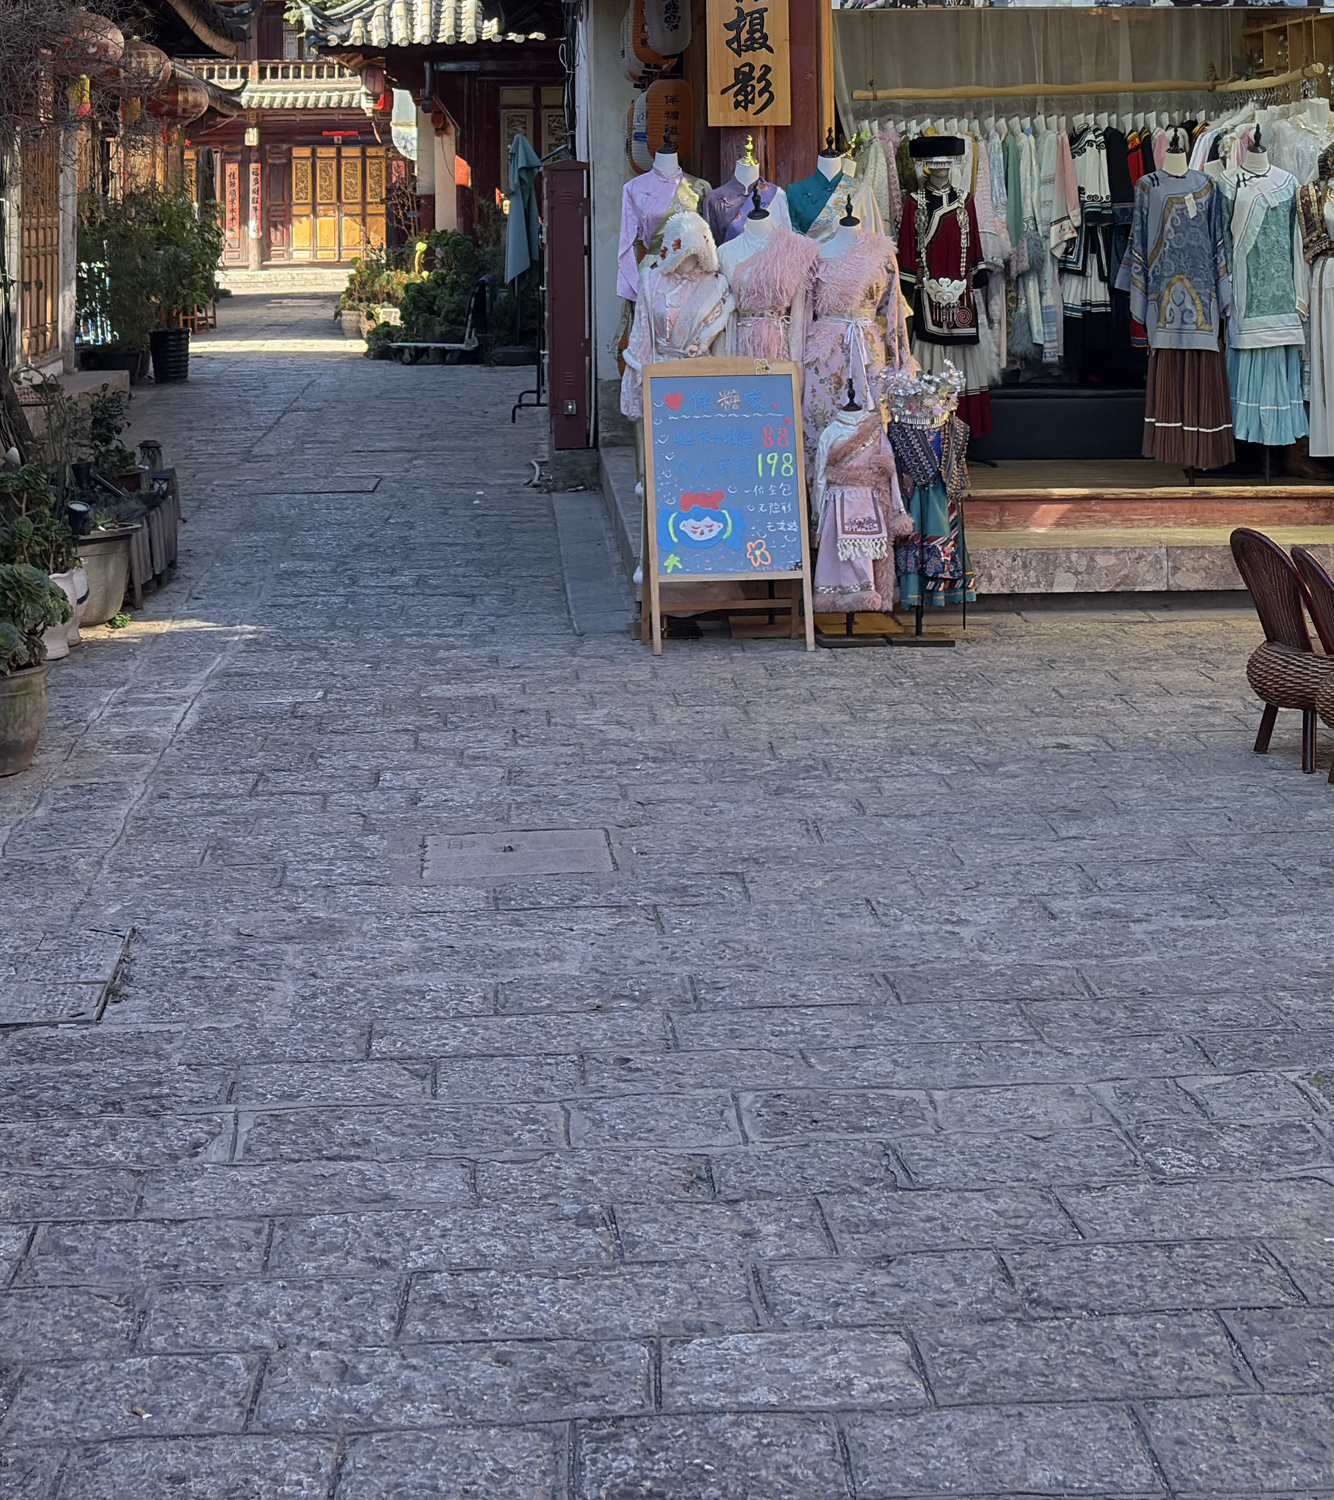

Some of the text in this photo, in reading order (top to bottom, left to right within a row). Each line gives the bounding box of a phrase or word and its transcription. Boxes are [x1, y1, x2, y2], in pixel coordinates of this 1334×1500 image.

[689, 389, 767, 412] 伴糖家
[762, 425, 789, 448] 88
[757, 452, 794, 478] 198
